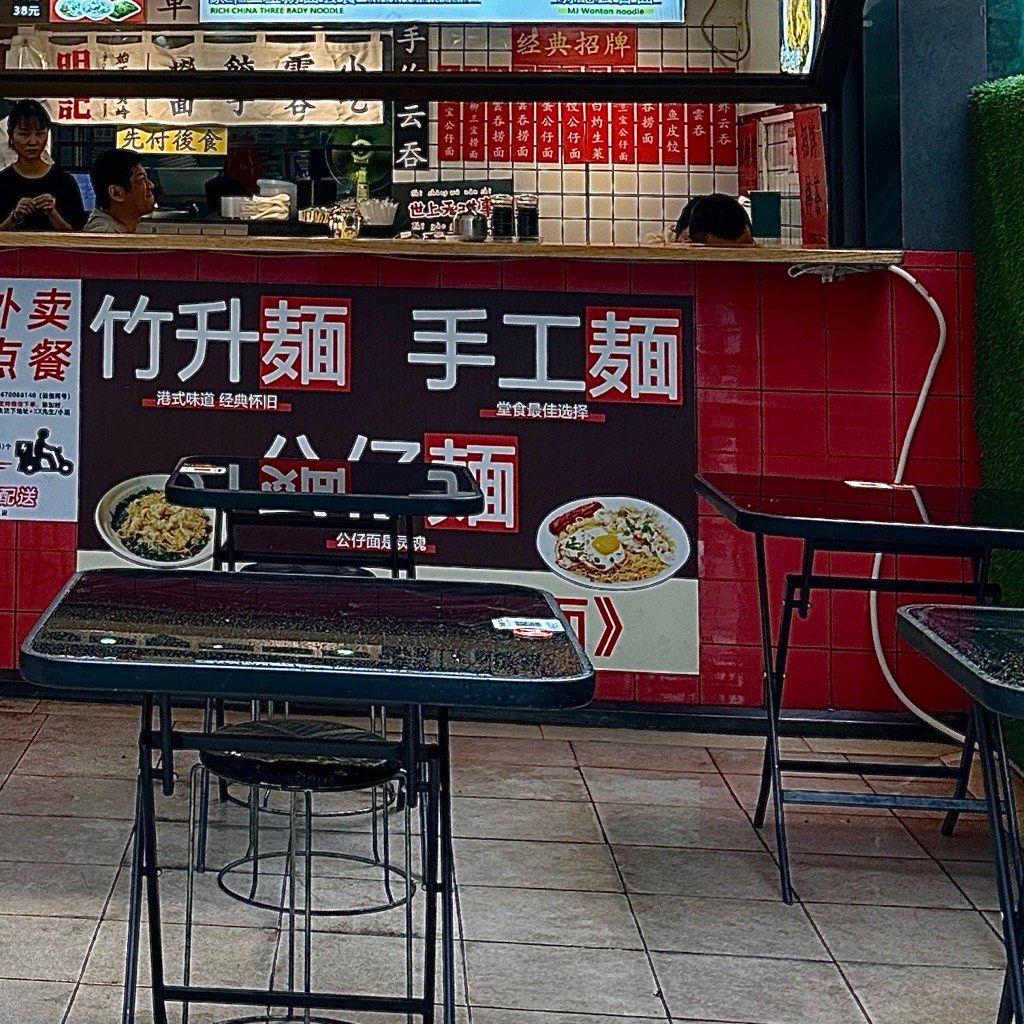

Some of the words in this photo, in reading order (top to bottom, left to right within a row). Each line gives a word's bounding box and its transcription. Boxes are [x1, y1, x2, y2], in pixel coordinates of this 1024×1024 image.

[13, 5, 41, 17] 38元
[516, 29, 632, 59] 经典招牌
[123, 128, 224, 152] 先付後食
[157, 391, 215, 407] 港式味道
[219, 393, 277, 410] 经典怀旧
[496, 401, 589, 420] 堂食最佳选择
